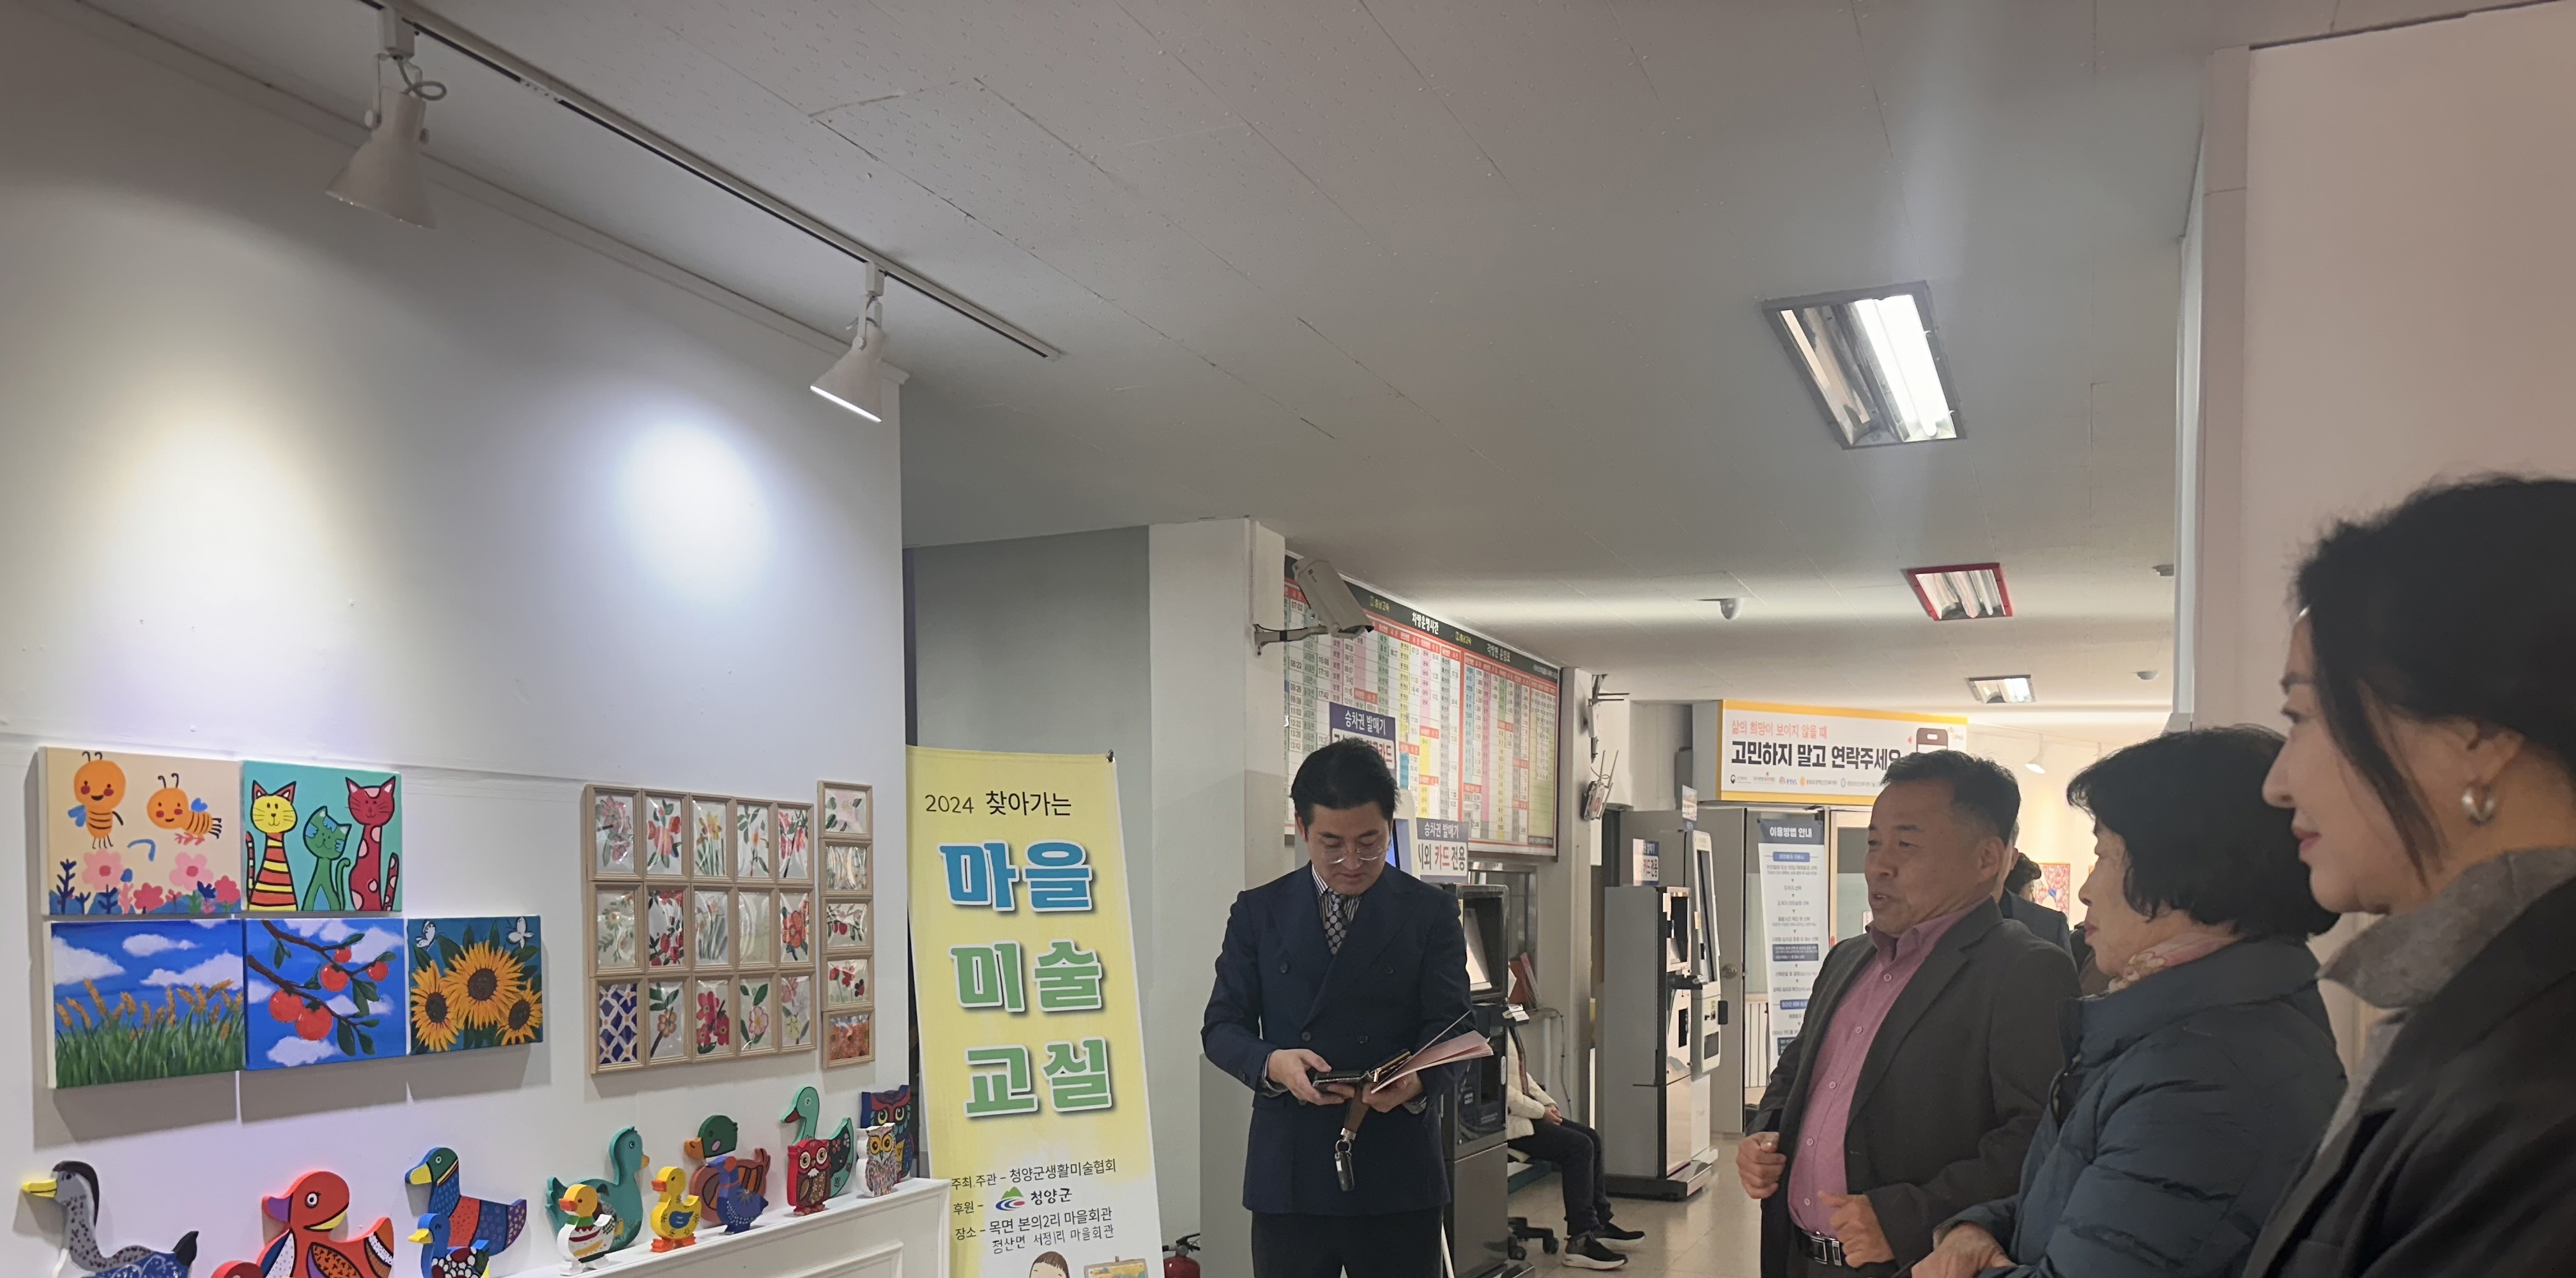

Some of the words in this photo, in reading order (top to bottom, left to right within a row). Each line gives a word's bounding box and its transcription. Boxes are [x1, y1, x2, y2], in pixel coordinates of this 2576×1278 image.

[1345, 710, 1365, 731] 승차권
[1366, 715, 1386, 735] 발매기
[1731, 720, 1747, 735] 삶의
[1749, 721, 1773, 736] 희망이
[1776, 723, 1798, 738] 보이지
[1802, 725, 1817, 739] 않을
[1819, 726, 1827, 740] 때
[1731, 740, 1792, 766] 고민하지
[1797, 744, 1826, 767] 말고
[924, 793, 974, 815] 2024
[985, 790, 1072, 818] 찾아가는
[1424, 822, 1441, 837] 승차권
[1443, 823, 1459, 839] 발매기
[1770, 826, 1797, 837] 이용방법
[1798, 827, 1812, 838] 안내
[1435, 844, 1450, 871] 카드
[1451, 846, 1466, 871] 전용
[939, 841, 1092, 911] 마을
[949, 939, 1102, 1012] 미술
[964, 1036, 1113, 1117] 교실
[1009, 1159, 1117, 1183] 청양군생활미술협회
[953, 1201, 974, 1215] 후원
[1031, 1187, 1073, 1205] 청양군
[955, 1227, 977, 1240] 장소
[990, 1218, 1014, 1235] 목면
[1018, 1213, 1061, 1232] 본의2리
[1064, 1206, 1112, 1225] 마을회관
[992, 1235, 1025, 1254] 정산면
[1071, 1224, 1114, 1242] 마을회관
